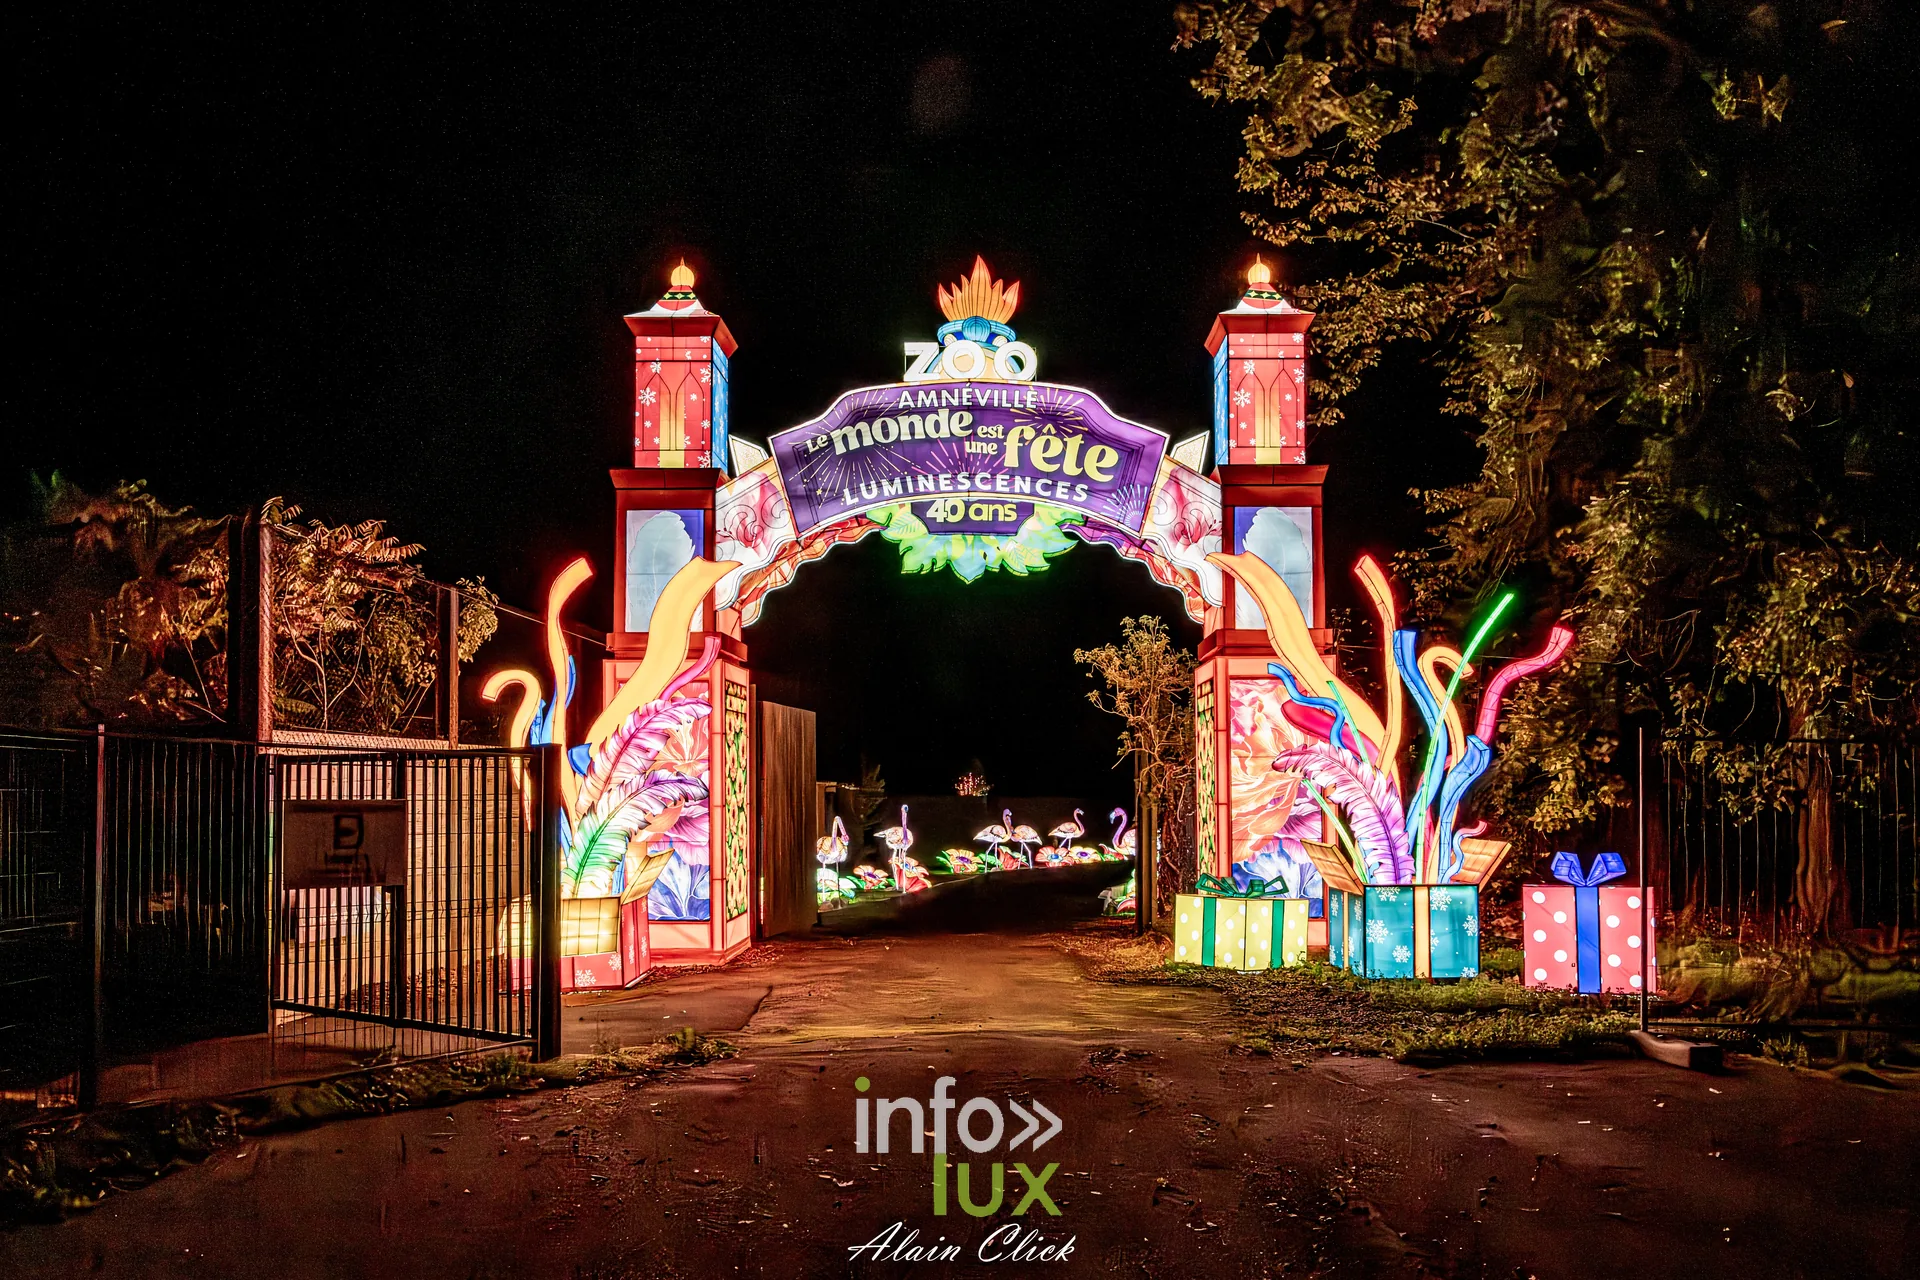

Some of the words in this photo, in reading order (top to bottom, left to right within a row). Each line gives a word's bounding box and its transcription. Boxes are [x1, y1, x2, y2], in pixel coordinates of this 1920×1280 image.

[904, 341, 1038, 381] ZOO
[898, 384, 1038, 409] AMNÉVILLE
[807, 434, 828, 454] Le
[832, 410, 973, 456] monde
[977, 425, 1004, 440] est
[966, 440, 998, 455] une
[1004, 425, 1119, 482] fête
[844, 473, 1089, 506] LUMINESCENCES
[927, 500, 964, 523] 40
[969, 501, 1017, 522] ans
